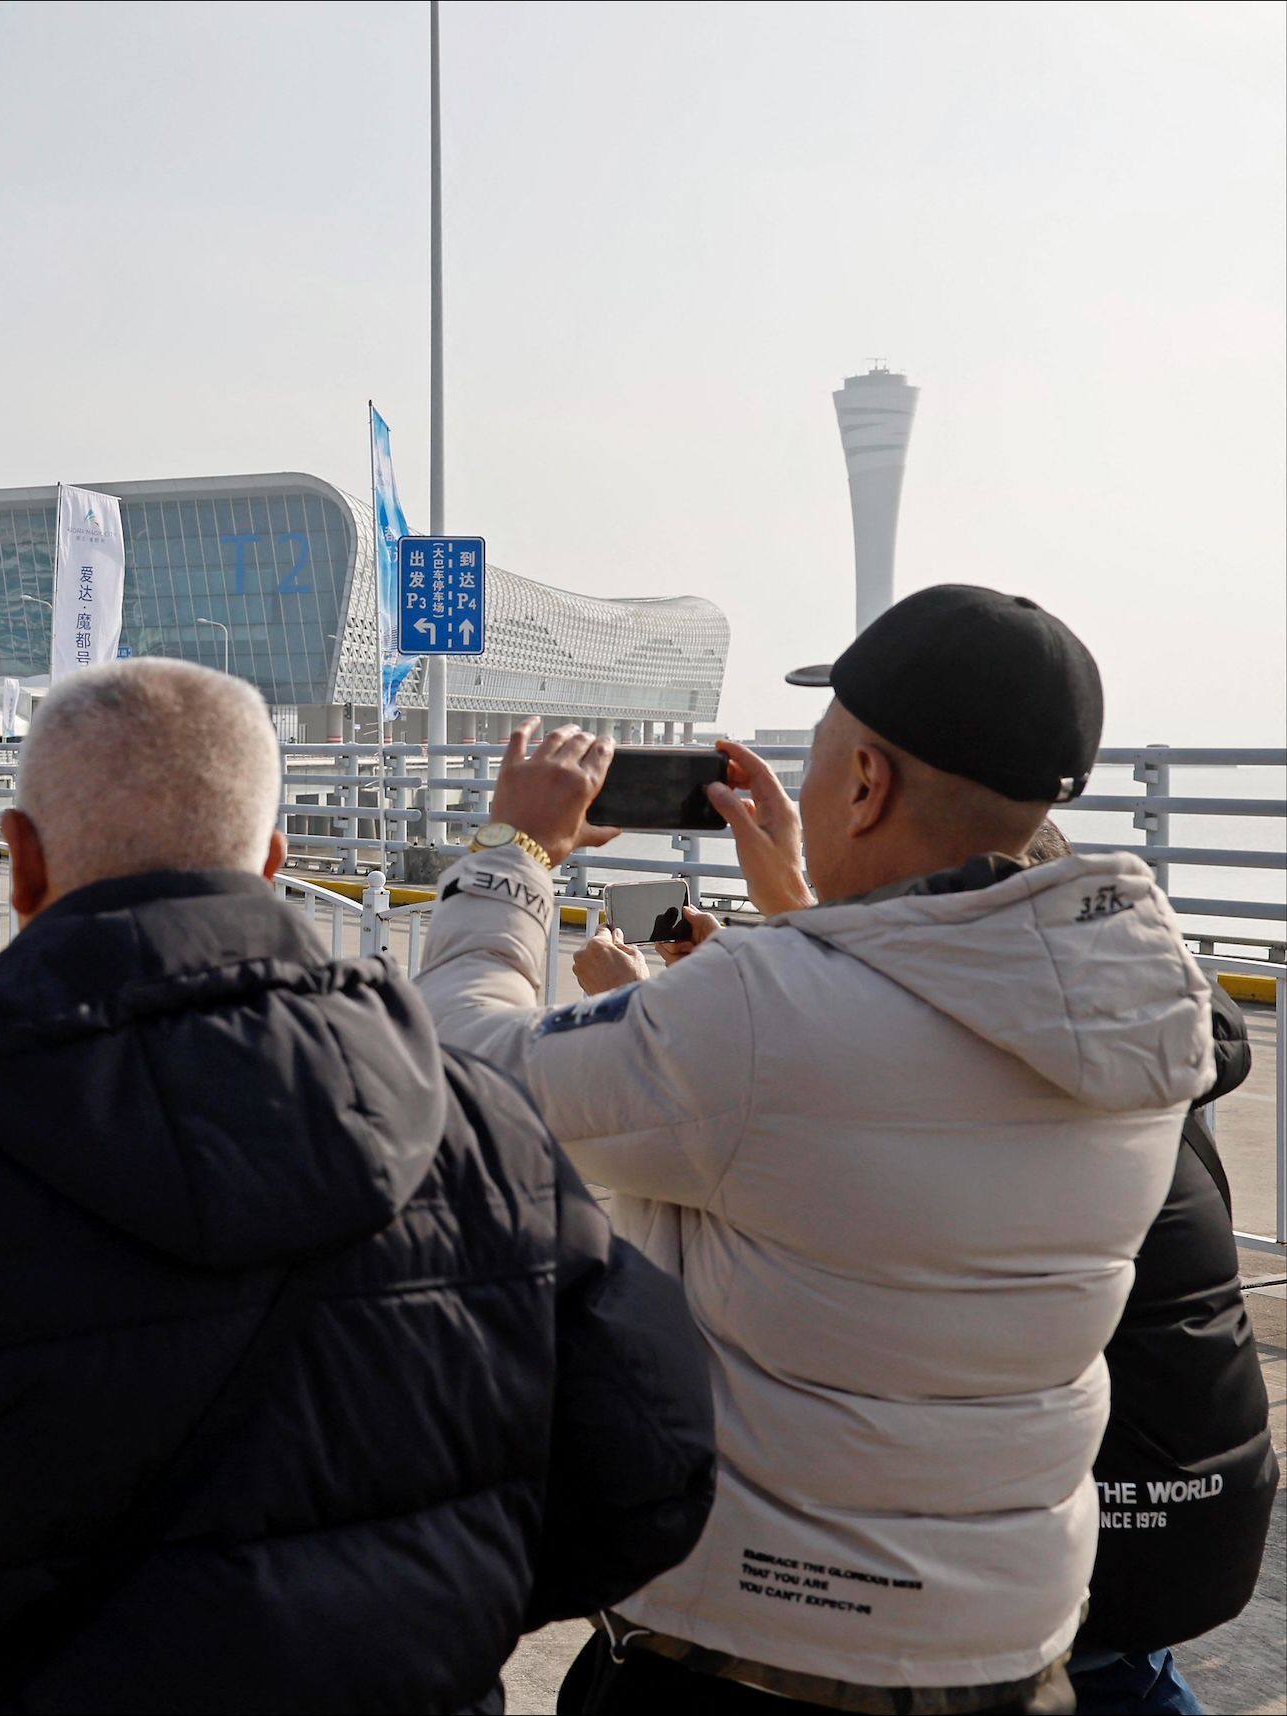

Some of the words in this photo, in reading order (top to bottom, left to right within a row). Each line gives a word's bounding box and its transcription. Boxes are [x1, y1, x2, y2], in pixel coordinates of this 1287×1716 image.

[220, 532, 313, 595] T2
[409, 550, 425, 588] 出发
[459, 550, 476, 588] 到达
[406, 592, 427, 610] P3
[457, 592, 477, 610] P4
[473, 871, 550, 923] NAIVE
[1147, 1473, 1224, 1504] WORLD
[1135, 1511, 1167, 1529] 1976
[741, 1563, 771, 1579] THAT
[773, 1571, 800, 1585] YOU
[802, 1578, 829, 1591] ARE
[802, 1562, 826, 1574] THE
[738, 1579, 763, 1594] YOU
